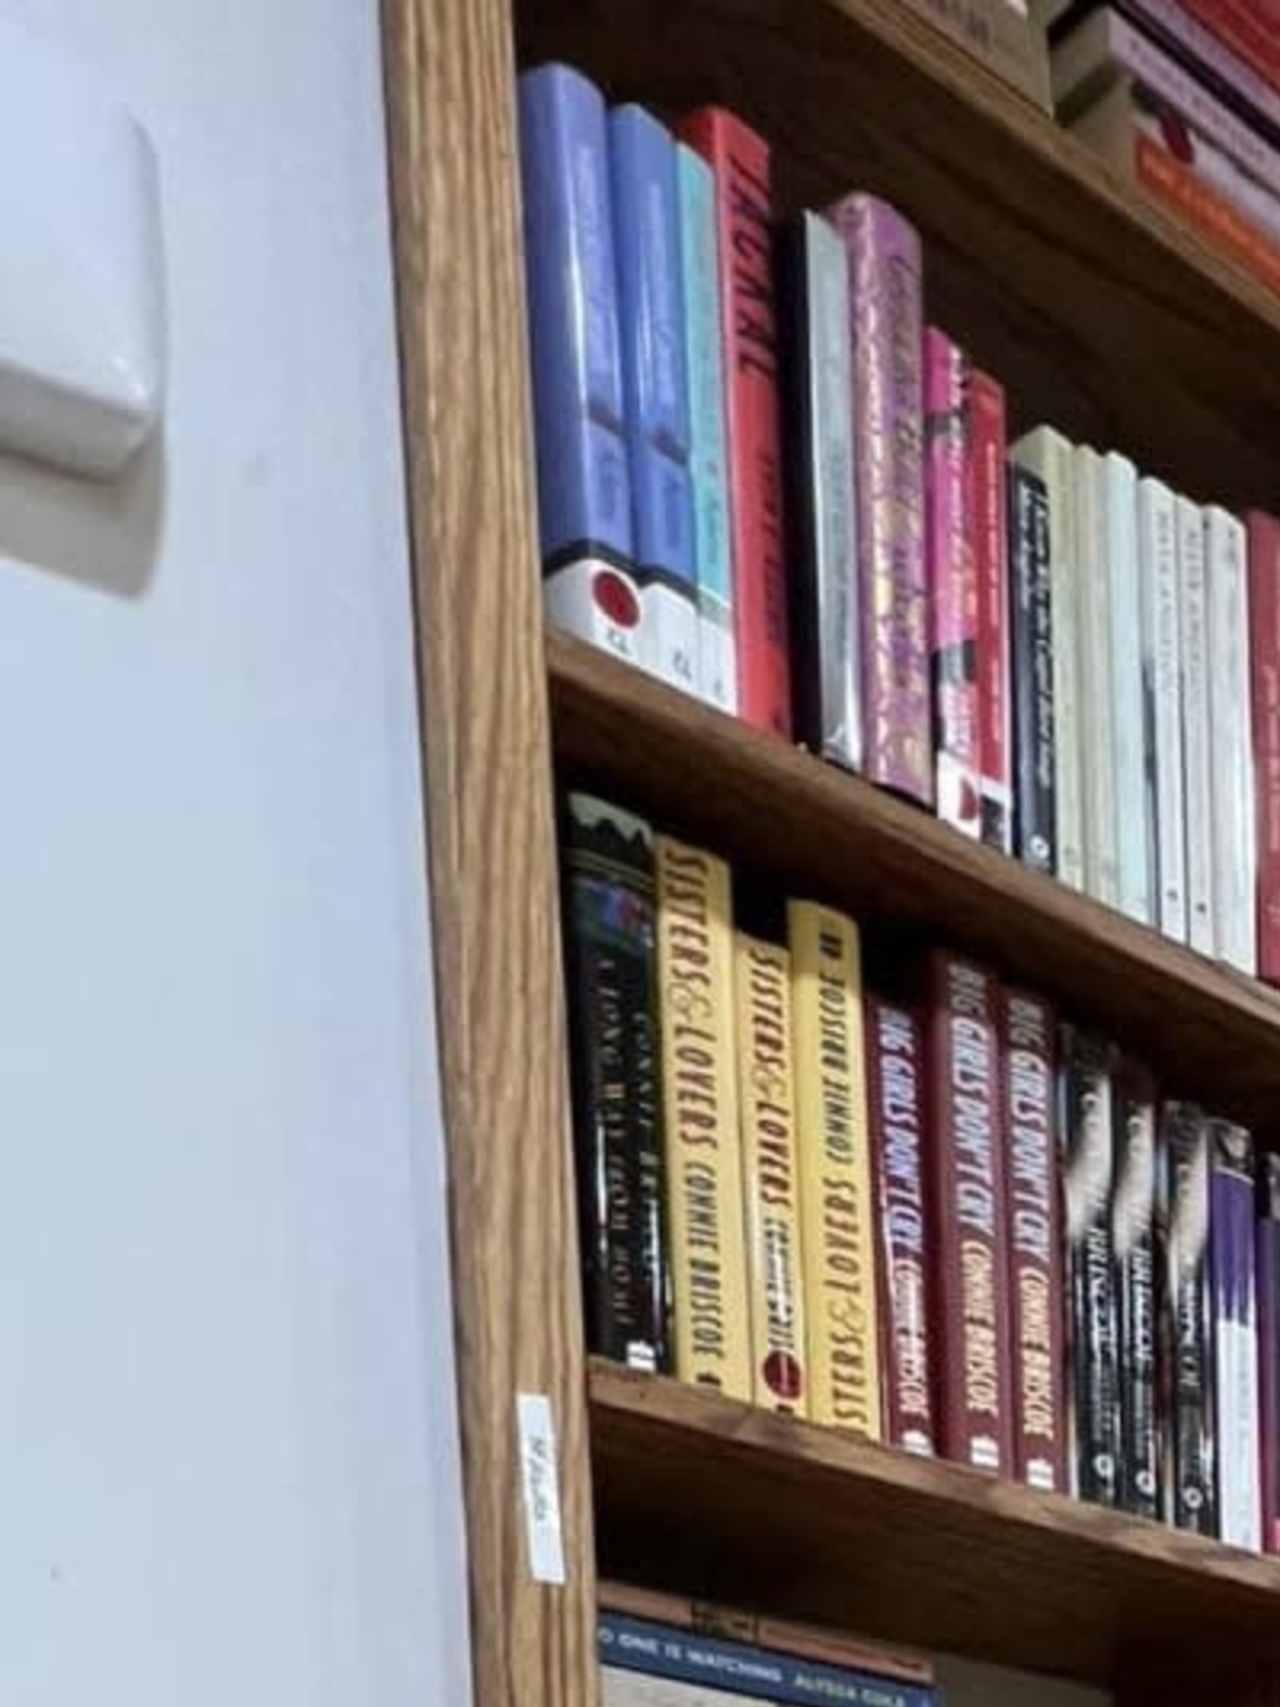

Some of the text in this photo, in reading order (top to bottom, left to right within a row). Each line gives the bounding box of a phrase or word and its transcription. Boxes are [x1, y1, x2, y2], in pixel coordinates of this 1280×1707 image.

[662, 848, 712, 986] SISTERS
[750, 948, 788, 1068] SISTERS
[818, 970, 850, 1070] BRISCOE
[880, 1006, 914, 1052] BIG
[948, 962, 986, 1016] BIG
[675, 1024, 720, 1150] LOVERS
[882, 1056, 918, 1123] GIRLS
[952, 1018, 992, 1094] GIRLS
[760, 1100, 793, 1208] LOVERS
[820, 1077, 855, 1165] CONNIE
[883, 1124, 920, 1204] DON'T
[955, 1096, 992, 1178] DON'T
[682, 1160, 720, 1254] CONNIE
[823, 1177, 862, 1294] LOVERS
[888, 1203, 922, 1258] CRY
[958, 1178, 996, 1236] CRY
[1009, 996, 1054, 1441] BIG GIRLS DON'T CRY CONNIE BRISCOE
[690, 1256, 725, 1360] BRISCOE
[961, 1240, 996, 1322] CONNIE
[826, 1332, 868, 1425] STERS
[965, 1323, 999, 1417] BRISCOE
[618, 1632, 660, 1657] ONE
[686, 1641, 784, 1685] WATCHING
